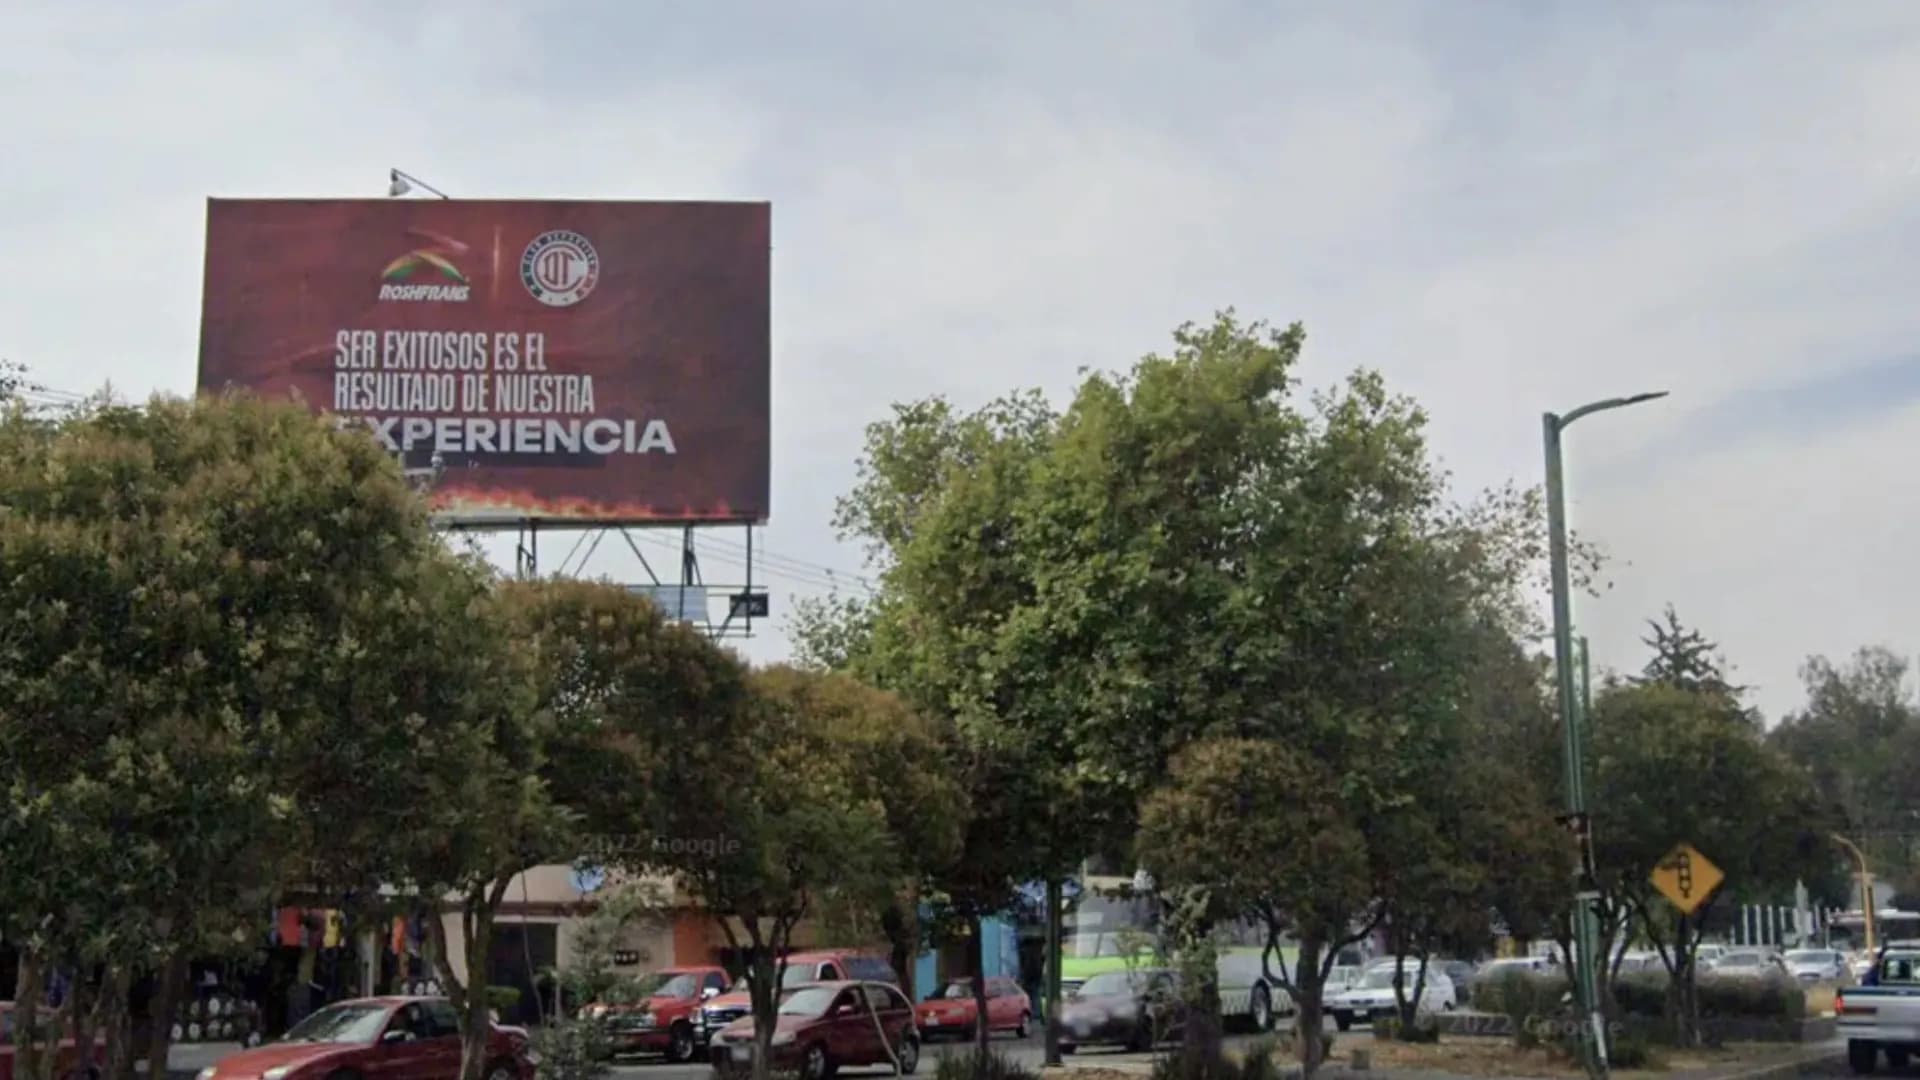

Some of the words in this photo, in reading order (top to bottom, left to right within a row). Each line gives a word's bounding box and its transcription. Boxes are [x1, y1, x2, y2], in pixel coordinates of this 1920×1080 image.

[378, 284, 469, 301] ROSHFRANS
[336, 329, 376, 370] SER
[383, 331, 488, 371] EXITOSOS
[494, 332, 519, 371] ES
[526, 333, 547, 372] EL
[334, 372, 455, 412] RESULTADO
[462, 374, 489, 413] DE
[495, 375, 596, 414] NUESTRA
